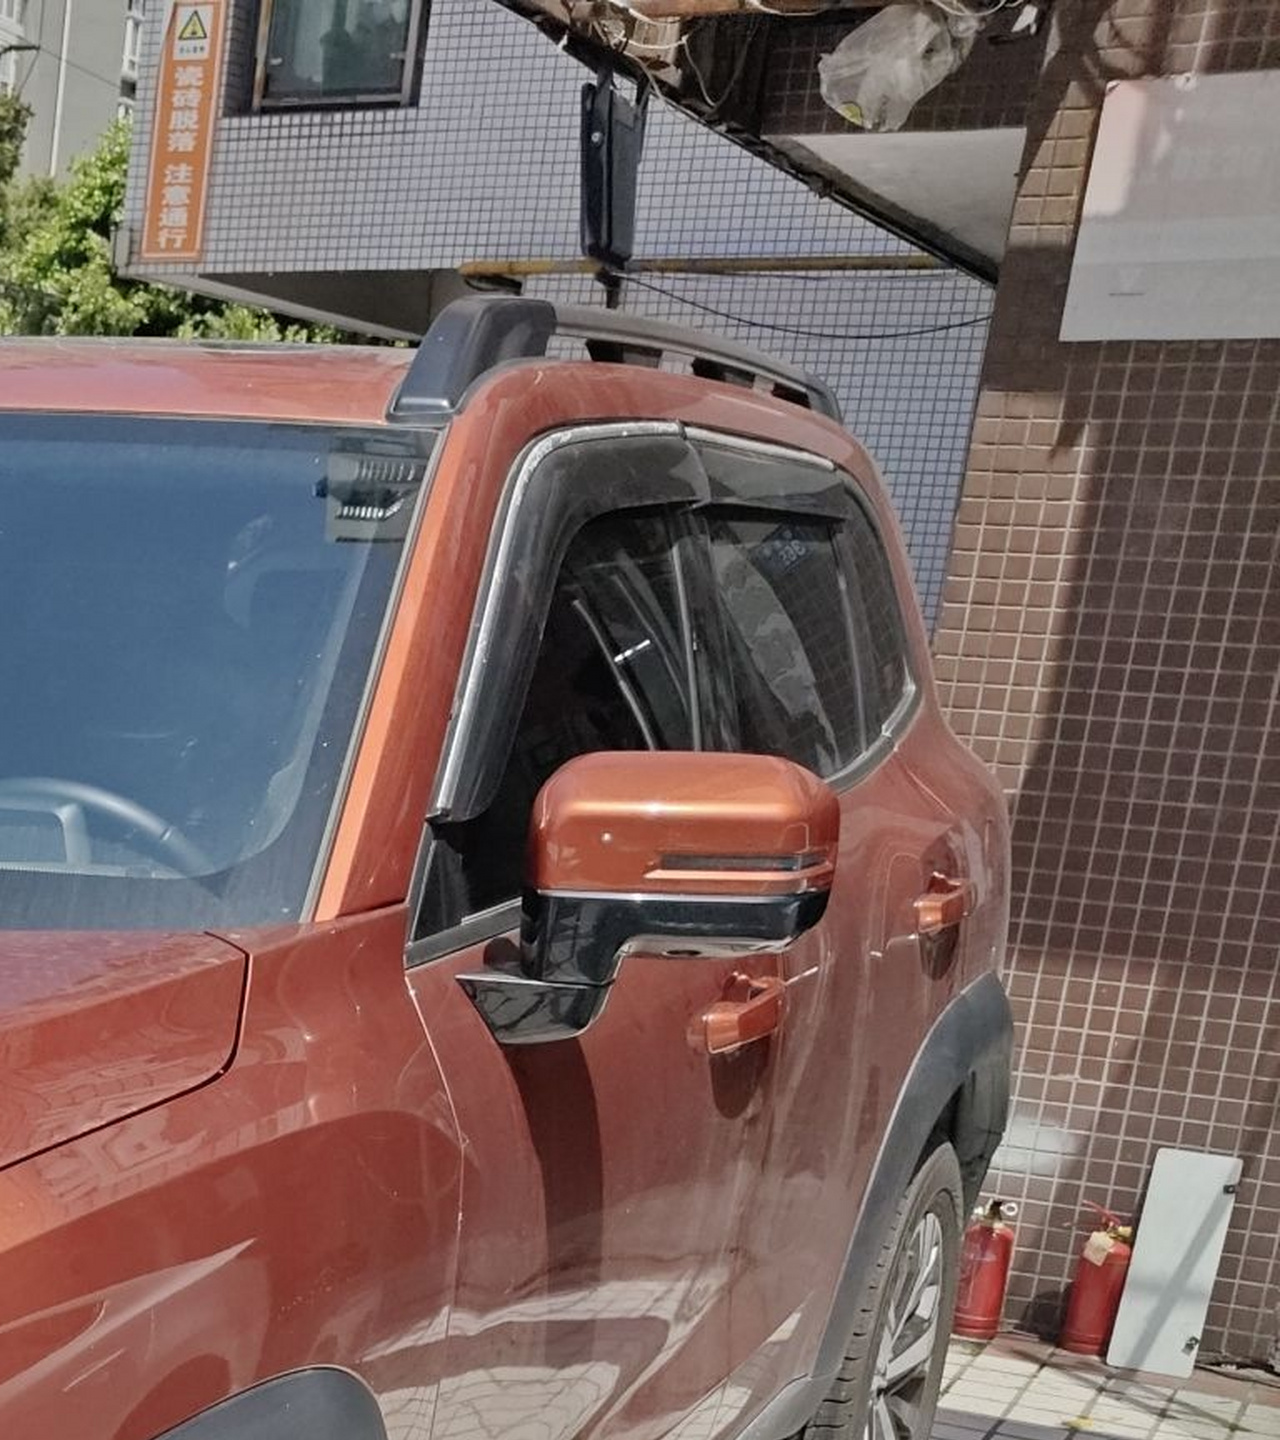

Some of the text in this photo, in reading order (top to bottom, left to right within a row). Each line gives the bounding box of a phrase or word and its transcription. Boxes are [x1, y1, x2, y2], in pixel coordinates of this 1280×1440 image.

[168, 65, 204, 152] 瓷砖脱落
[158, 163, 194, 249] 注意通行
